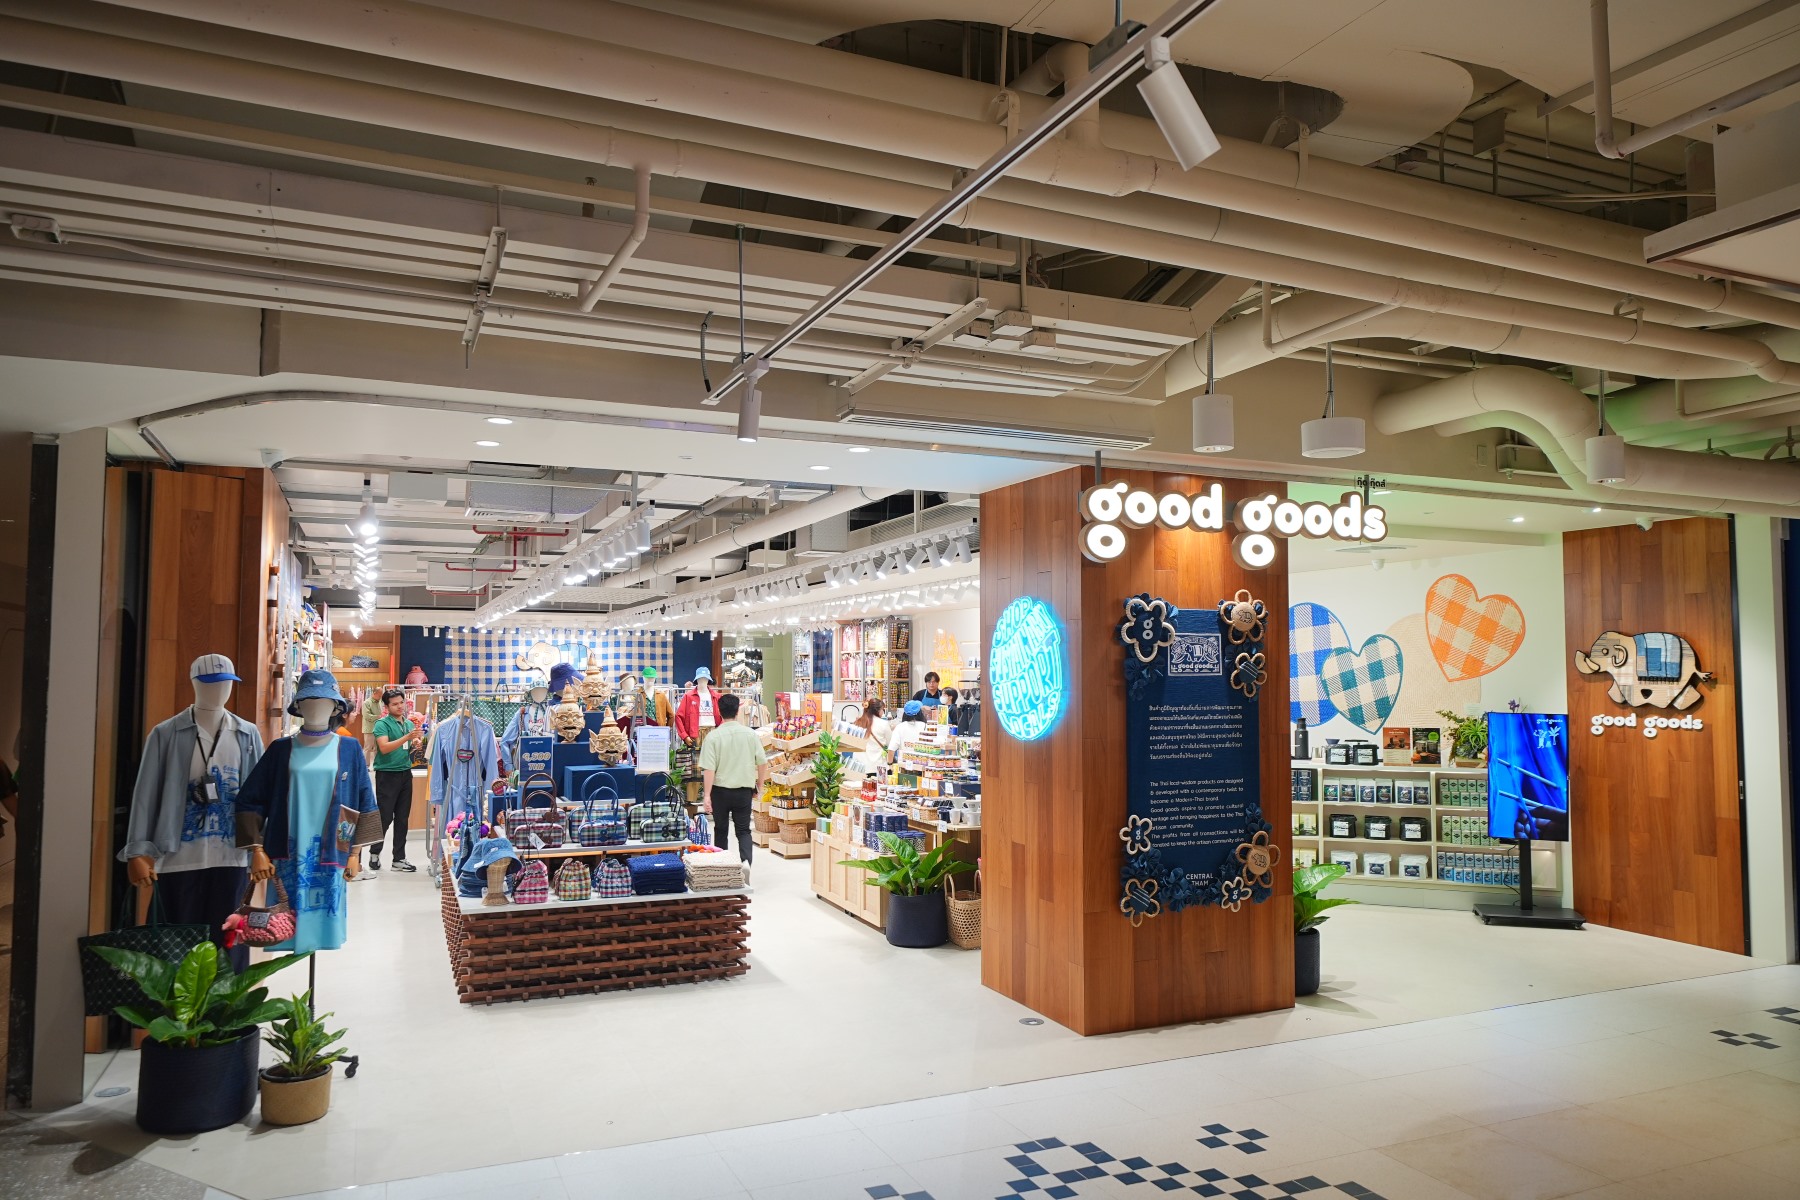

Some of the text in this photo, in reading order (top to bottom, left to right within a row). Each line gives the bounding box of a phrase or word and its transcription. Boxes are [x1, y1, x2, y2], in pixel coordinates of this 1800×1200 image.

[1085, 481, 1387, 568] good goods
[992, 596, 1033, 647] SHOP
[992, 628, 1062, 714] SUPPORT
[1178, 662, 1213, 672] good goods
[998, 690, 1062, 740] LOCALS
[1590, 712, 1704, 738] good goods
